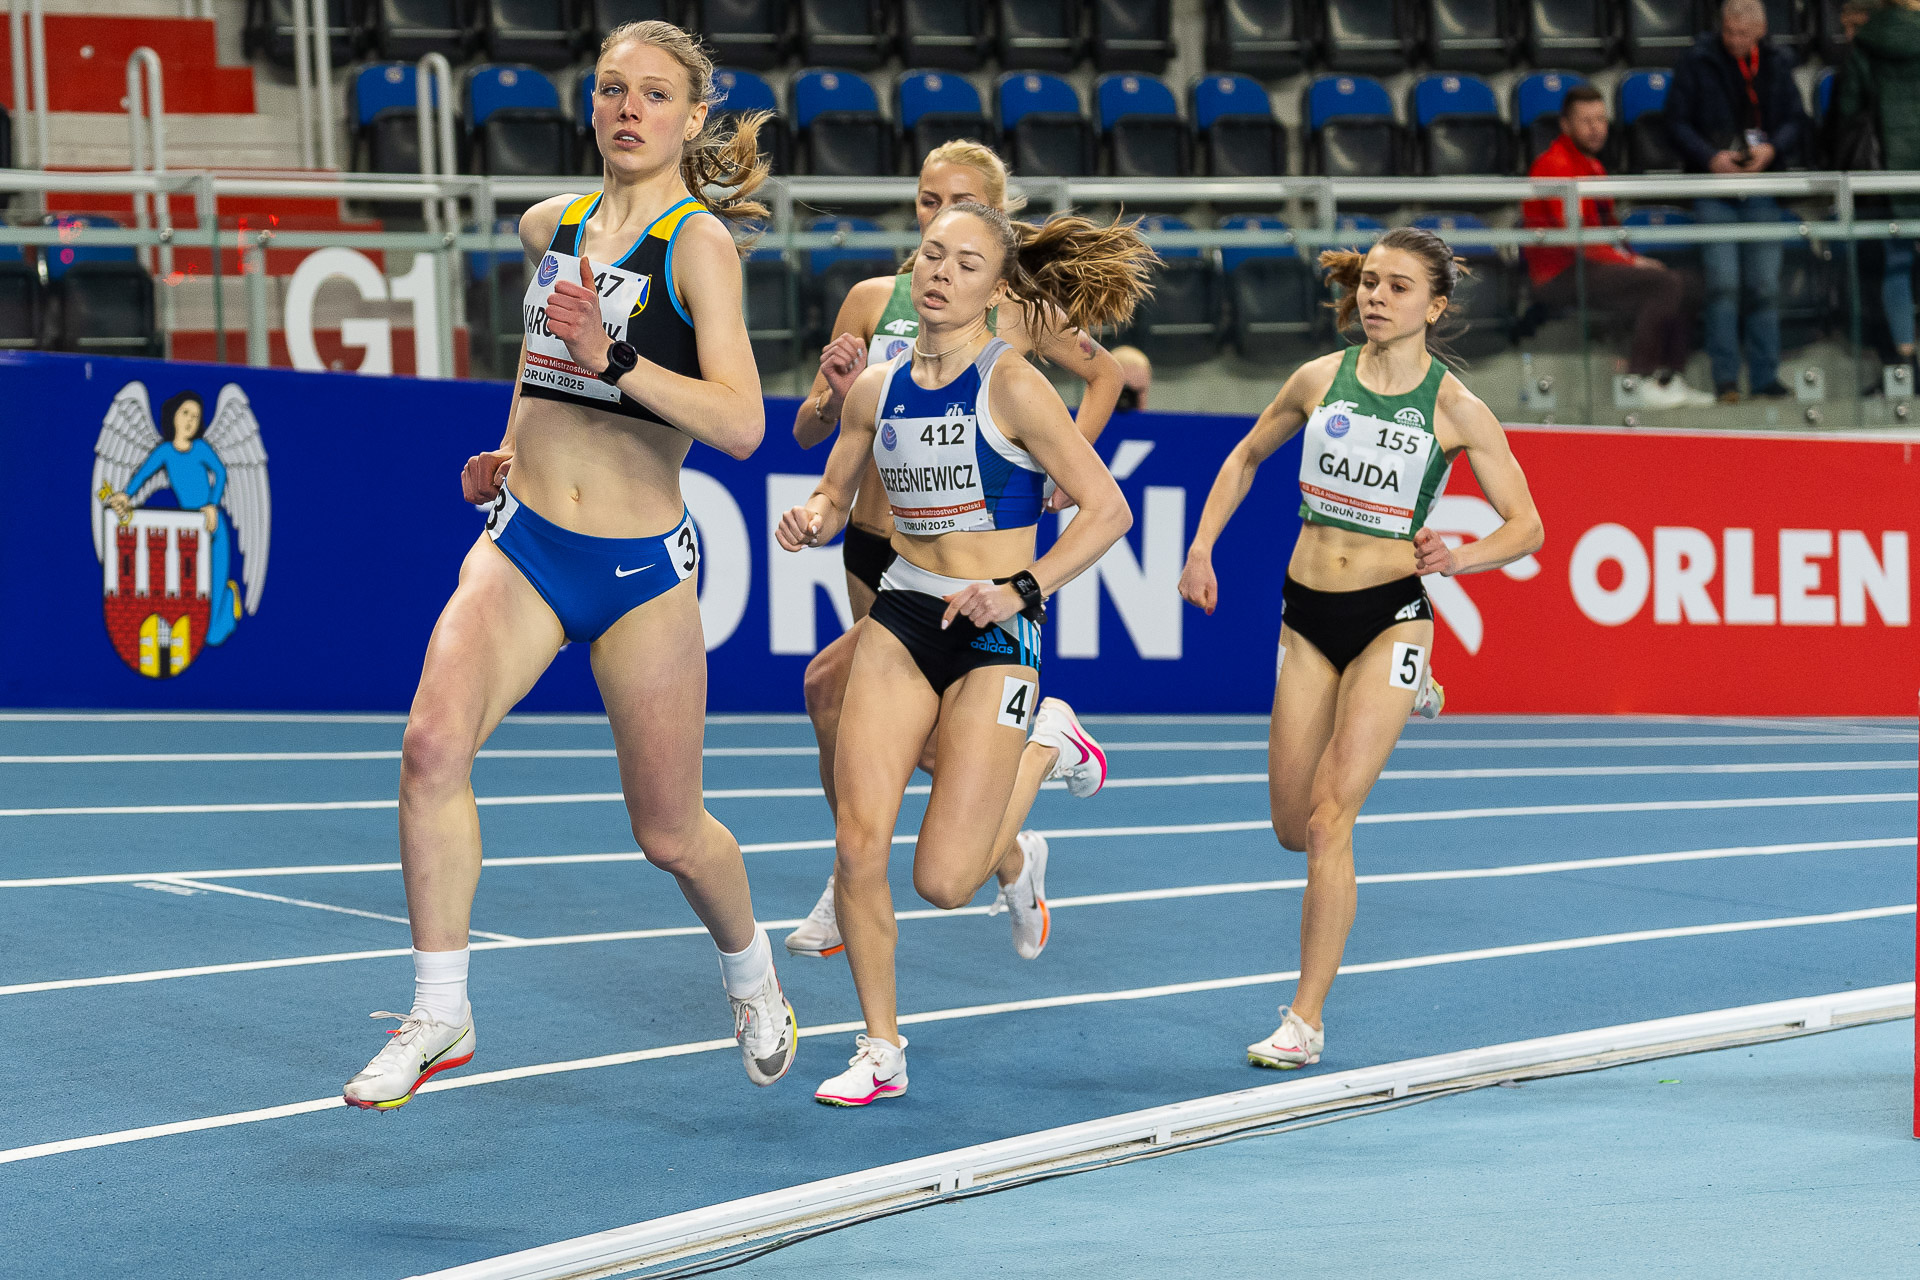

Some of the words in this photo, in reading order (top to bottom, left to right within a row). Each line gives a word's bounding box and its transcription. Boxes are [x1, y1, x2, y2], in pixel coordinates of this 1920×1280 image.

[284, 246, 439, 378] G1
[884, 318, 919, 335] 4F
[523, 368, 555, 385] ORUŃ
[557, 376, 585, 391] 2025
[920, 423, 965, 446] 412
[1376, 428, 1420, 455] 155
[880, 463, 976, 493] BEREŚNIEWICZ
[1319, 453, 1399, 493] GAJDA
[959, 502, 981, 512] Polski
[1320, 502, 1354, 518] TORUŃ
[1355, 512, 1381, 525] 2025
[903, 520, 927, 531] TORUŃ
[928, 519, 955, 531] 2025
[678, 527, 696, 572] 3
[1569, 522, 1911, 627] ORLEN
[1395, 598, 1421, 621] 4F
[970, 640, 1013, 655] adidas
[1400, 647, 1419, 685] 5
[1006, 684, 1028, 724] 4
